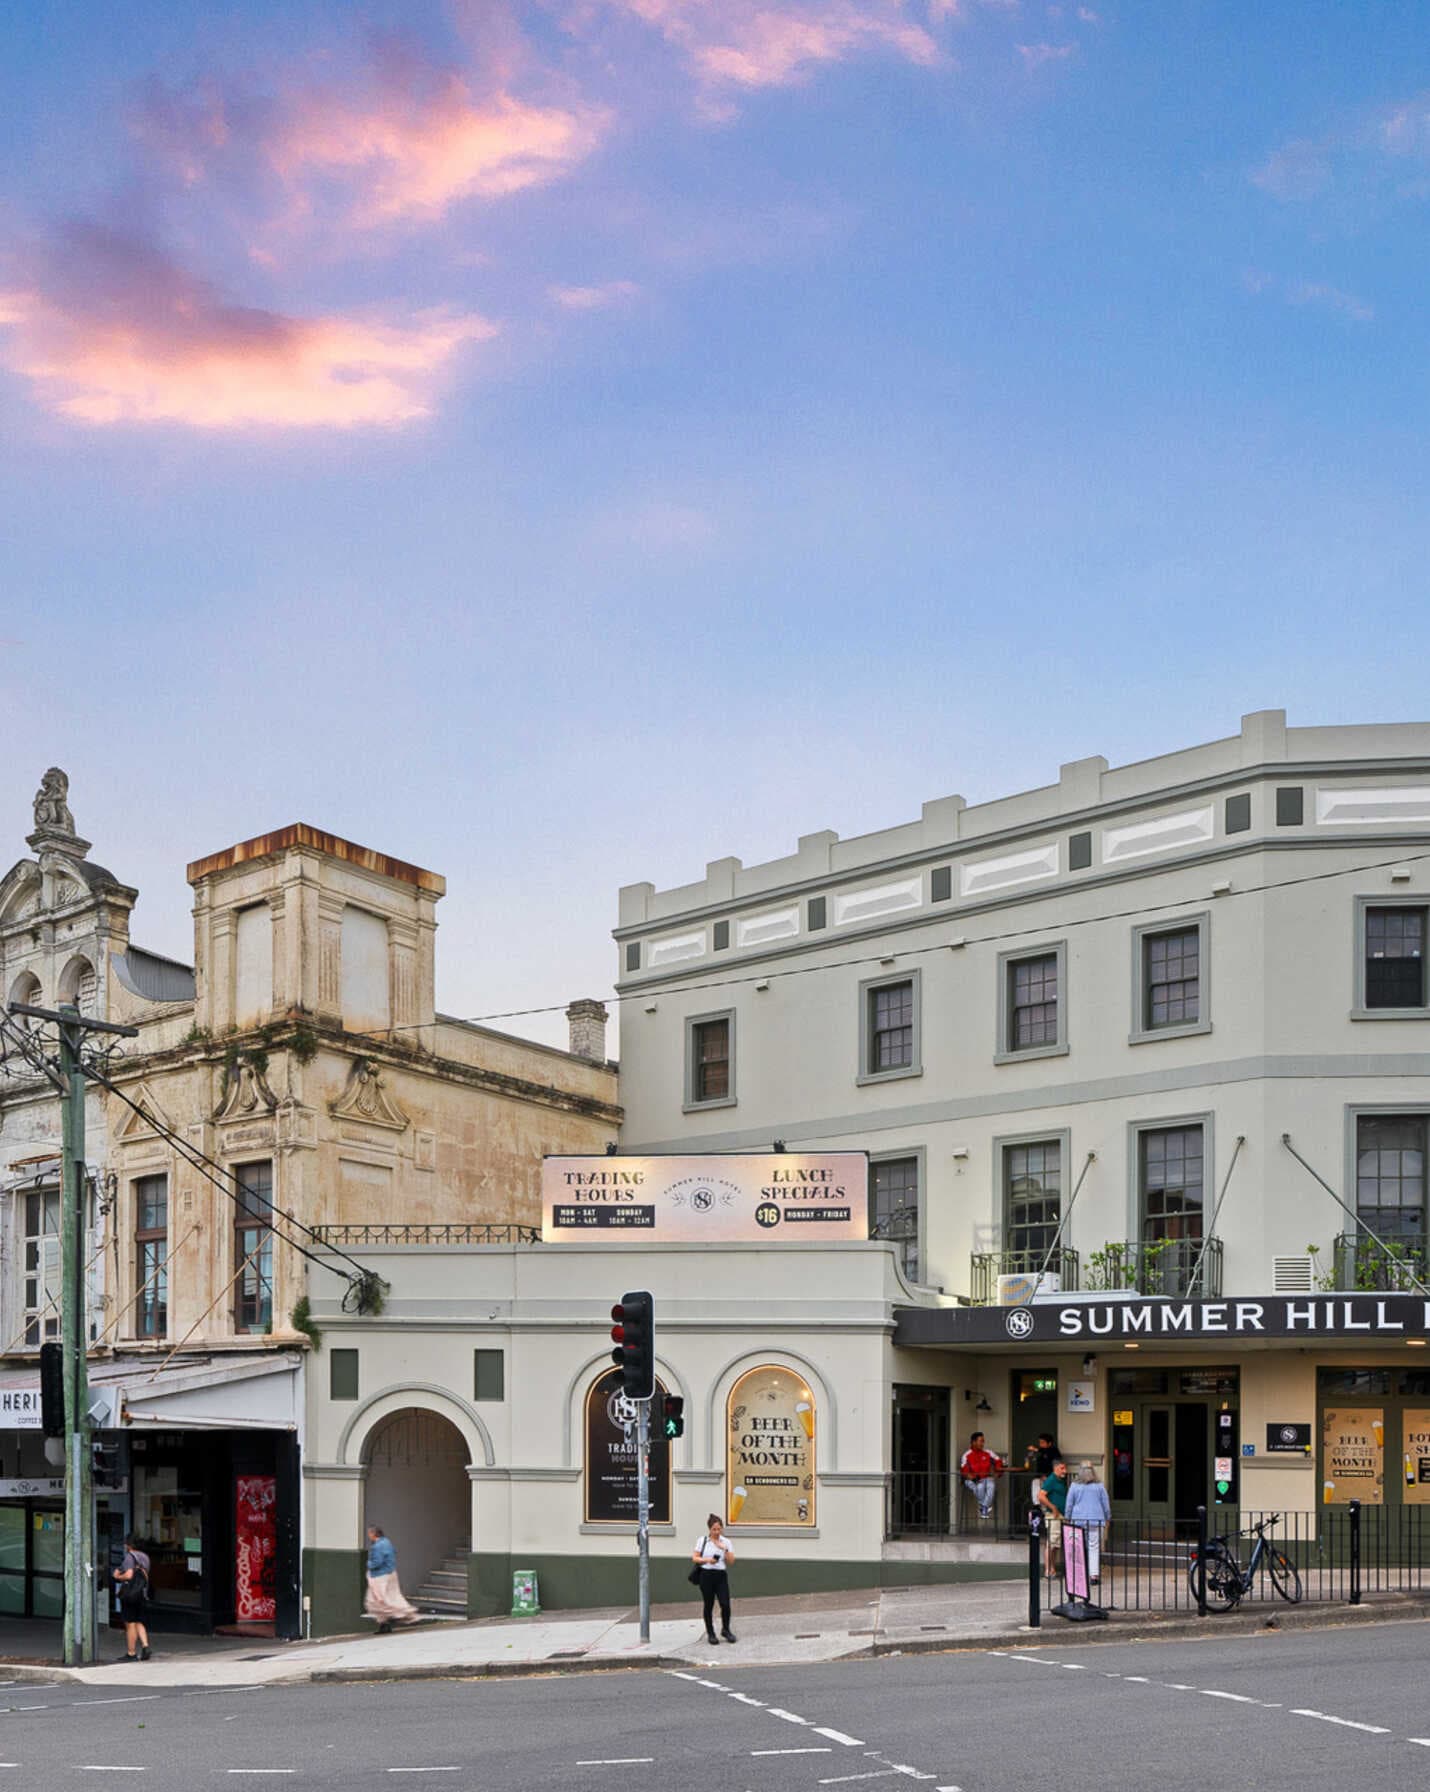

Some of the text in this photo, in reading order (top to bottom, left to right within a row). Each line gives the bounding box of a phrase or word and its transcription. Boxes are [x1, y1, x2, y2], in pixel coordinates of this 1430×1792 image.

[563, 1172, 644, 1185] TRADING
[773, 1169, 833, 1182] LUNCH
[574, 1188, 635, 1201] HOURS
[761, 1186, 846, 1200] SPECIALS
[757, 1207, 778, 1223] $16
[823, 1210, 847, 1218] FRIDAY
[1059, 1302, 1265, 1335] SUMMER
[1286, 1301, 1403, 1329] HILL
[751, 1417, 793, 1431] BEER
[741, 1434, 802, 1449] OF THE
[608, 1444, 650, 1454] TRADI
[738, 1452, 806, 1466] MONTH
